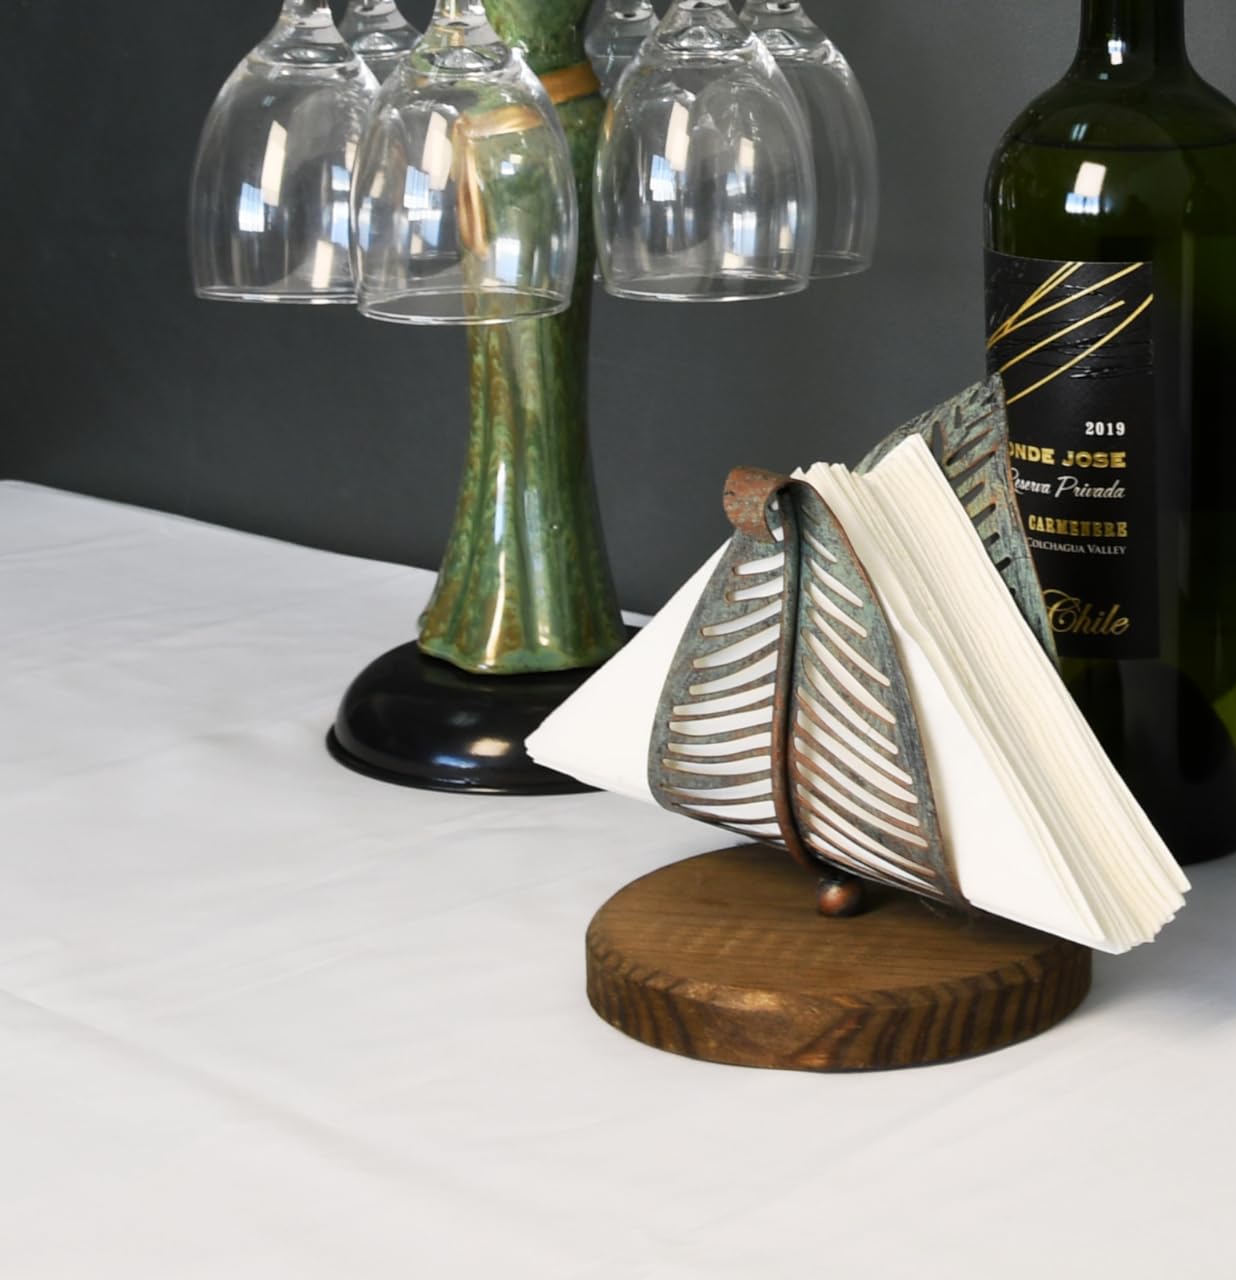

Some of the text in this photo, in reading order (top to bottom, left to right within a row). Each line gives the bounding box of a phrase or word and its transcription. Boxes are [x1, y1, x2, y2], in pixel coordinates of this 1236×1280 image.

[1085, 421, 1126, 436] 2019
[1062, 451, 1127, 468] JOSE
[1055, 475, 1126, 499] Privada
[1028, 515, 1128, 537] CARMENERE
[1042, 588, 1129, 636] Chile
